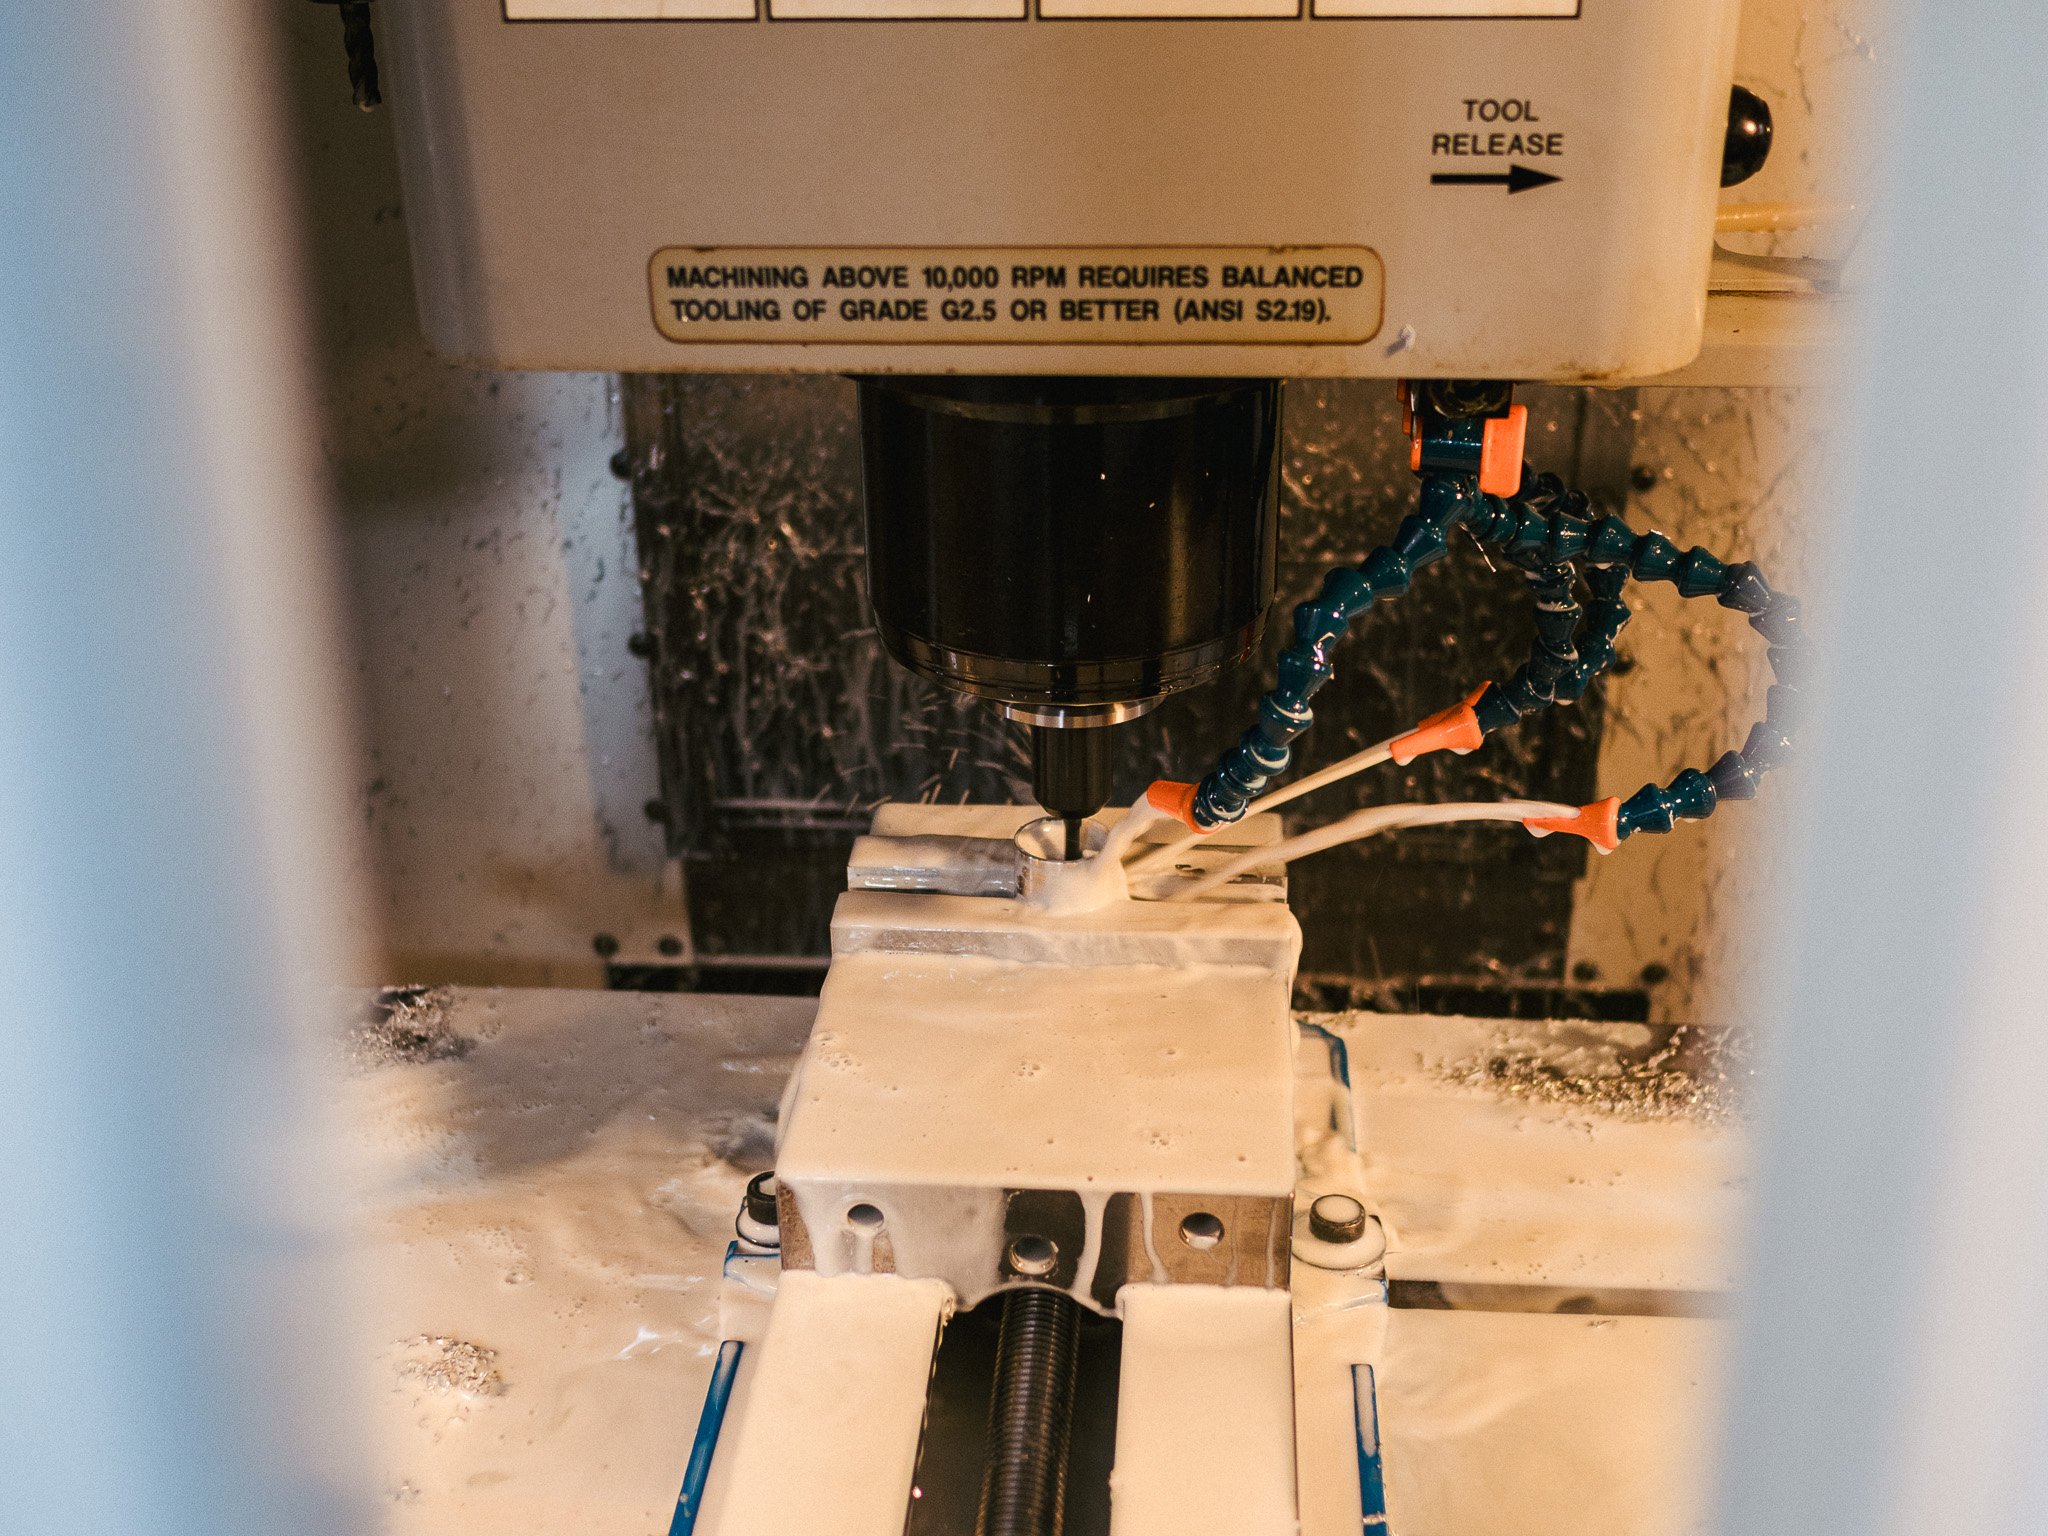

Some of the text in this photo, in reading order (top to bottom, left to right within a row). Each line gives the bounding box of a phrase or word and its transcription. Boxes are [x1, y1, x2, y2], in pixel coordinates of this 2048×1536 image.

[1463, 99, 1539, 122] TOOL
[1432, 132, 1564, 157] RELEASE
[666, 265, 1363, 293] MACHINING ABOVE 10,000 RPM REQUIRES BALANCED
[670, 297, 1331, 325] TOOLING OF GRADE G2.5 OR BETTER (ANSI S2.19).
